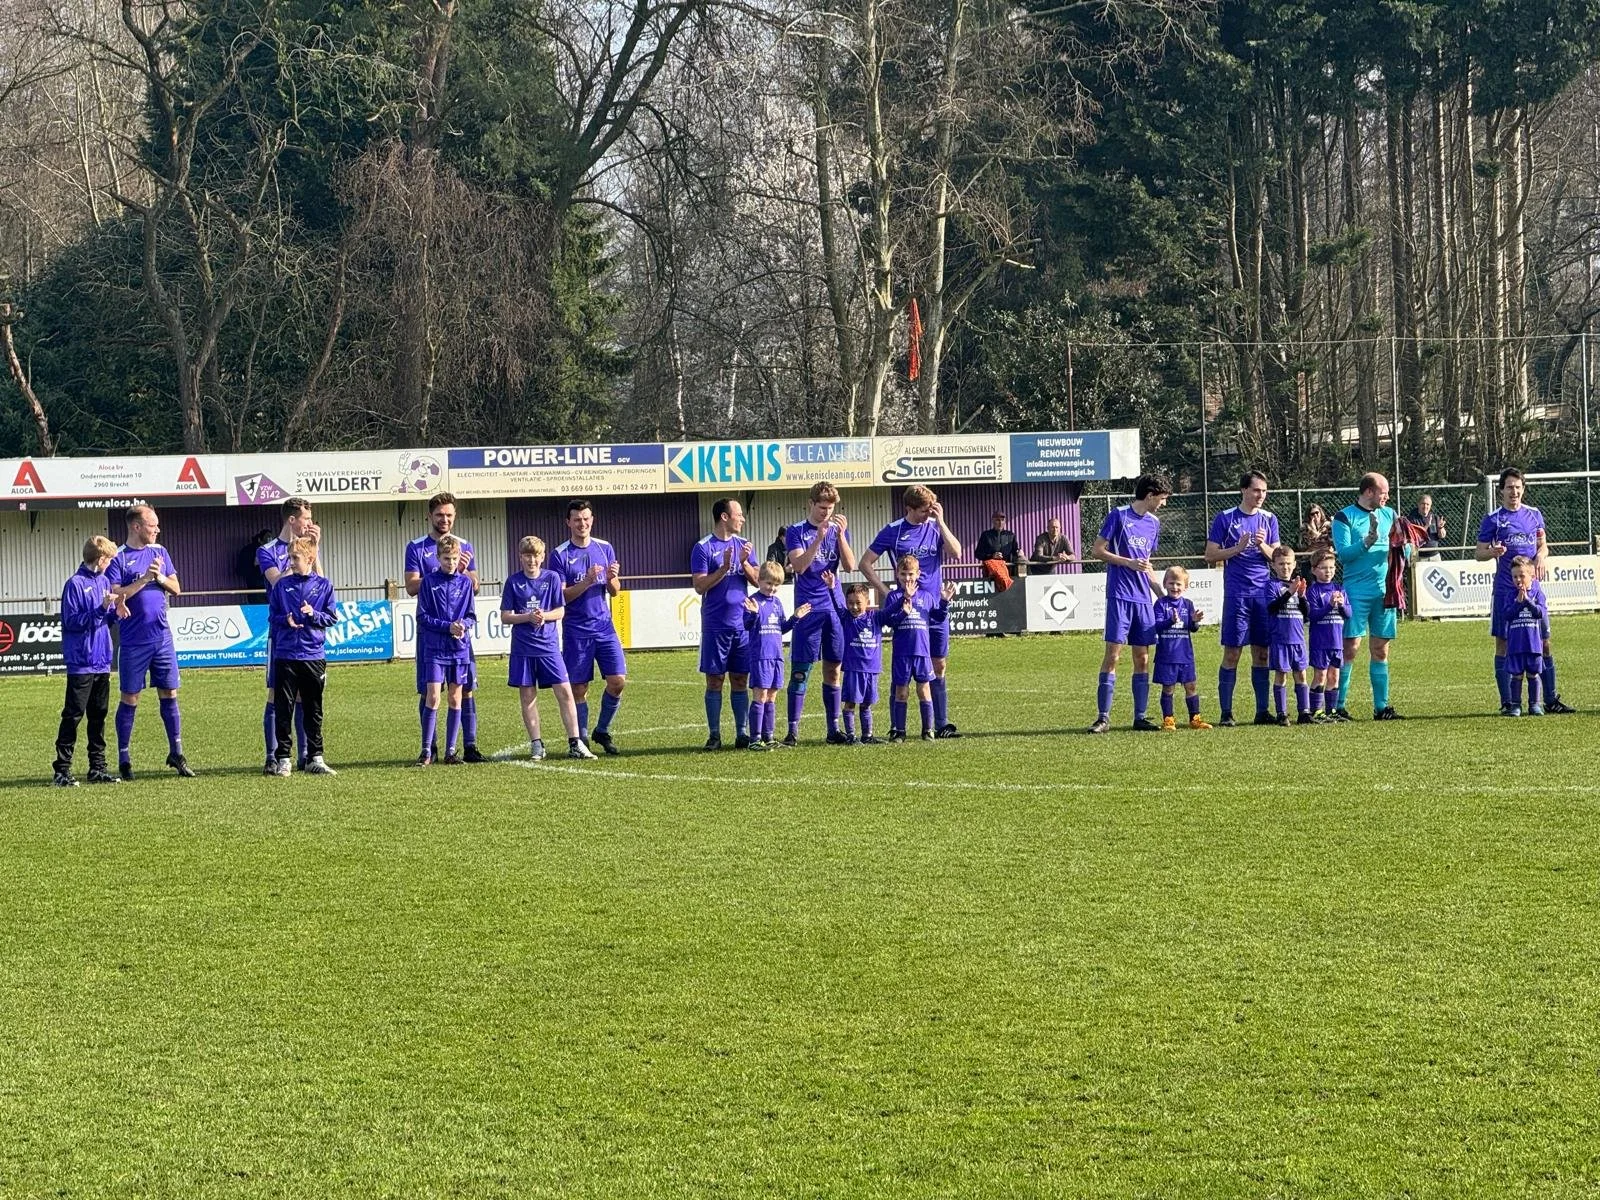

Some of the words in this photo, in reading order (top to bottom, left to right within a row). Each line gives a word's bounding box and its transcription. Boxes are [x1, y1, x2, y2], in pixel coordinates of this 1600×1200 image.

[1037, 438, 1083, 447] NIEUWBOUW
[788, 444, 868, 462] CLEANING
[937, 445, 996, 453] BEZETTINGSWERKEN
[1040, 449, 1081, 458] RENOVATIE
[484, 448, 611, 466] POWER-LINE
[698, 444, 782, 483] KENIS
[896, 457, 945, 477] Steven
[948, 461, 970, 475] Van
[974, 460, 996, 475] Giel
[1026, 459, 1095, 468] info@stevenvangiel.be
[786, 470, 871, 481] www.keniscleaning.com
[1026, 469, 1095, 477] www.stevenvangiel.be
[305, 477, 382, 492] WILDERT
[260, 490, 280, 499] 5142
[1554, 565, 1594, 581] Service
[1427, 569, 1455, 599] EBS
[988, 610, 997, 618] 56
[177, 616, 220, 635] JeS
[325, 606, 391, 647] WASH
[325, 646, 384, 656] ww.jscleaning.be
[177, 653, 217, 661] SOFTWASH
